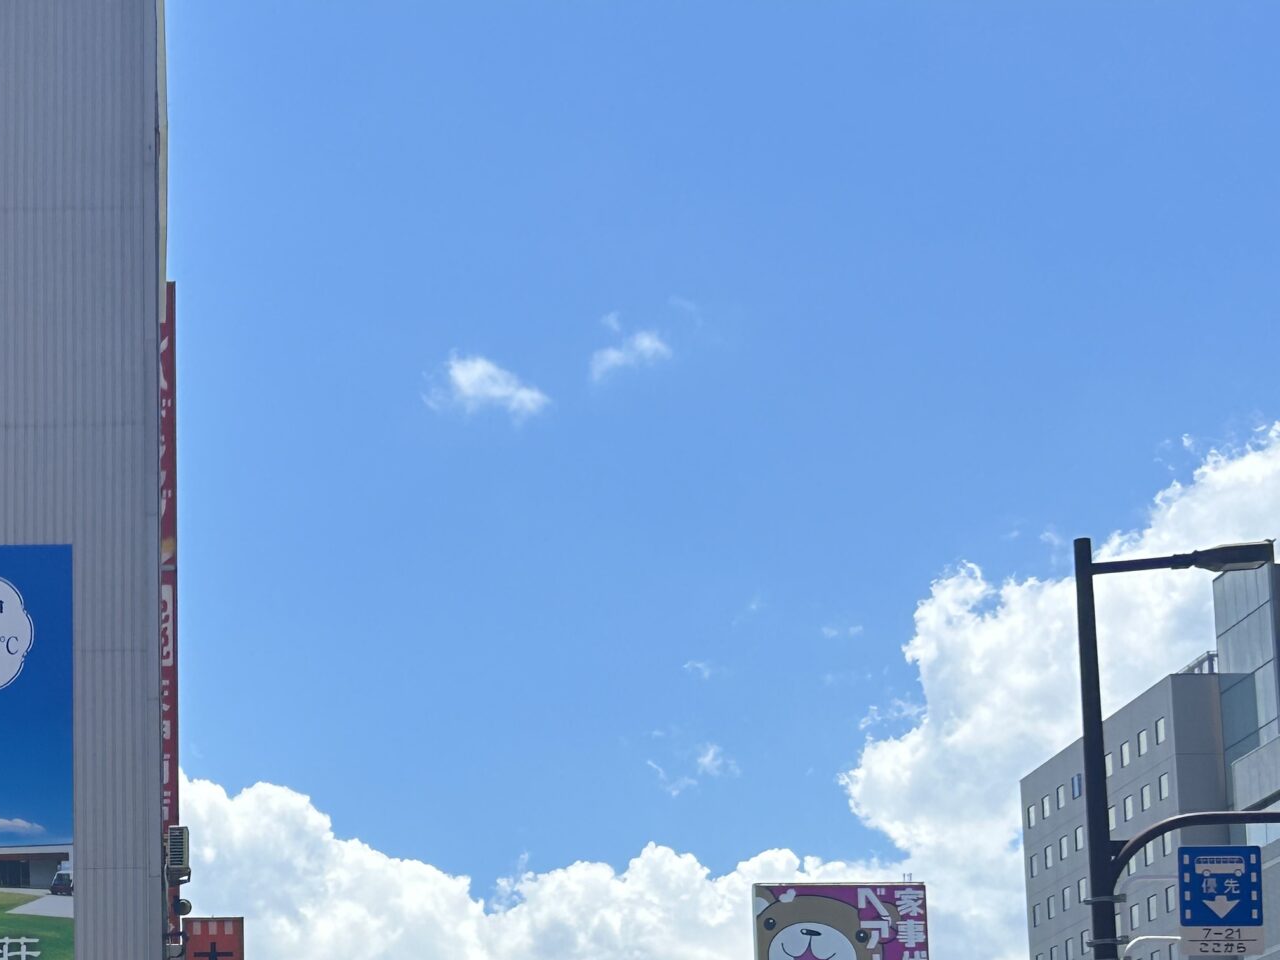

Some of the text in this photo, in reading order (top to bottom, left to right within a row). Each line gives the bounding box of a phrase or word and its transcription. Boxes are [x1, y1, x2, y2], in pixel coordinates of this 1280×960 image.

[1202, 928, 1241, 939] 7-21
[1199, 942, 1247, 953] ここから
